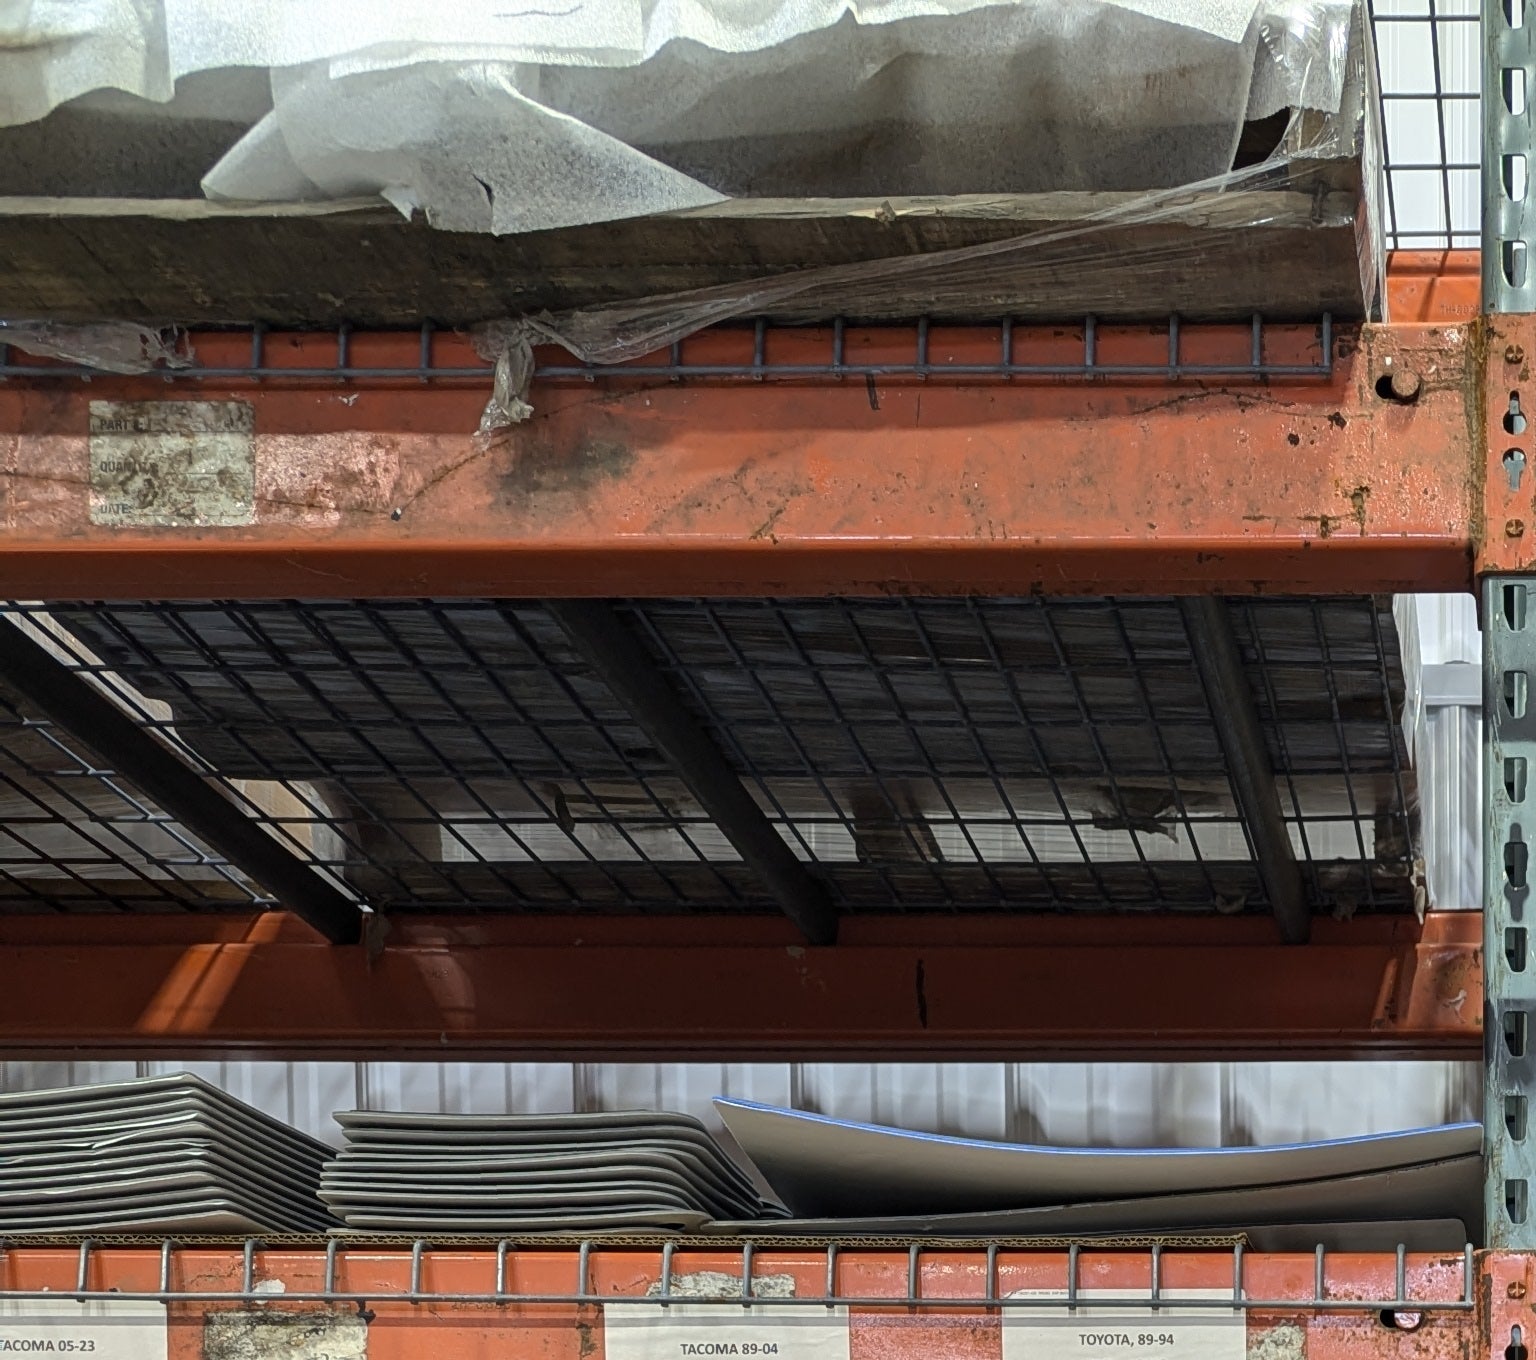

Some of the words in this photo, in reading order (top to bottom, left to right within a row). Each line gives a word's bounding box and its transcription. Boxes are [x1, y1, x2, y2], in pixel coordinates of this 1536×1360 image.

[58, 1340, 95, 1352] 05-23
[1079, 1334, 1134, 1348] TOYOTA,
[1138, 1334, 1174, 1346] 89-94
[680, 1343, 739, 1355] TACOMA
[742, 1343, 778, 1355] 89-04
